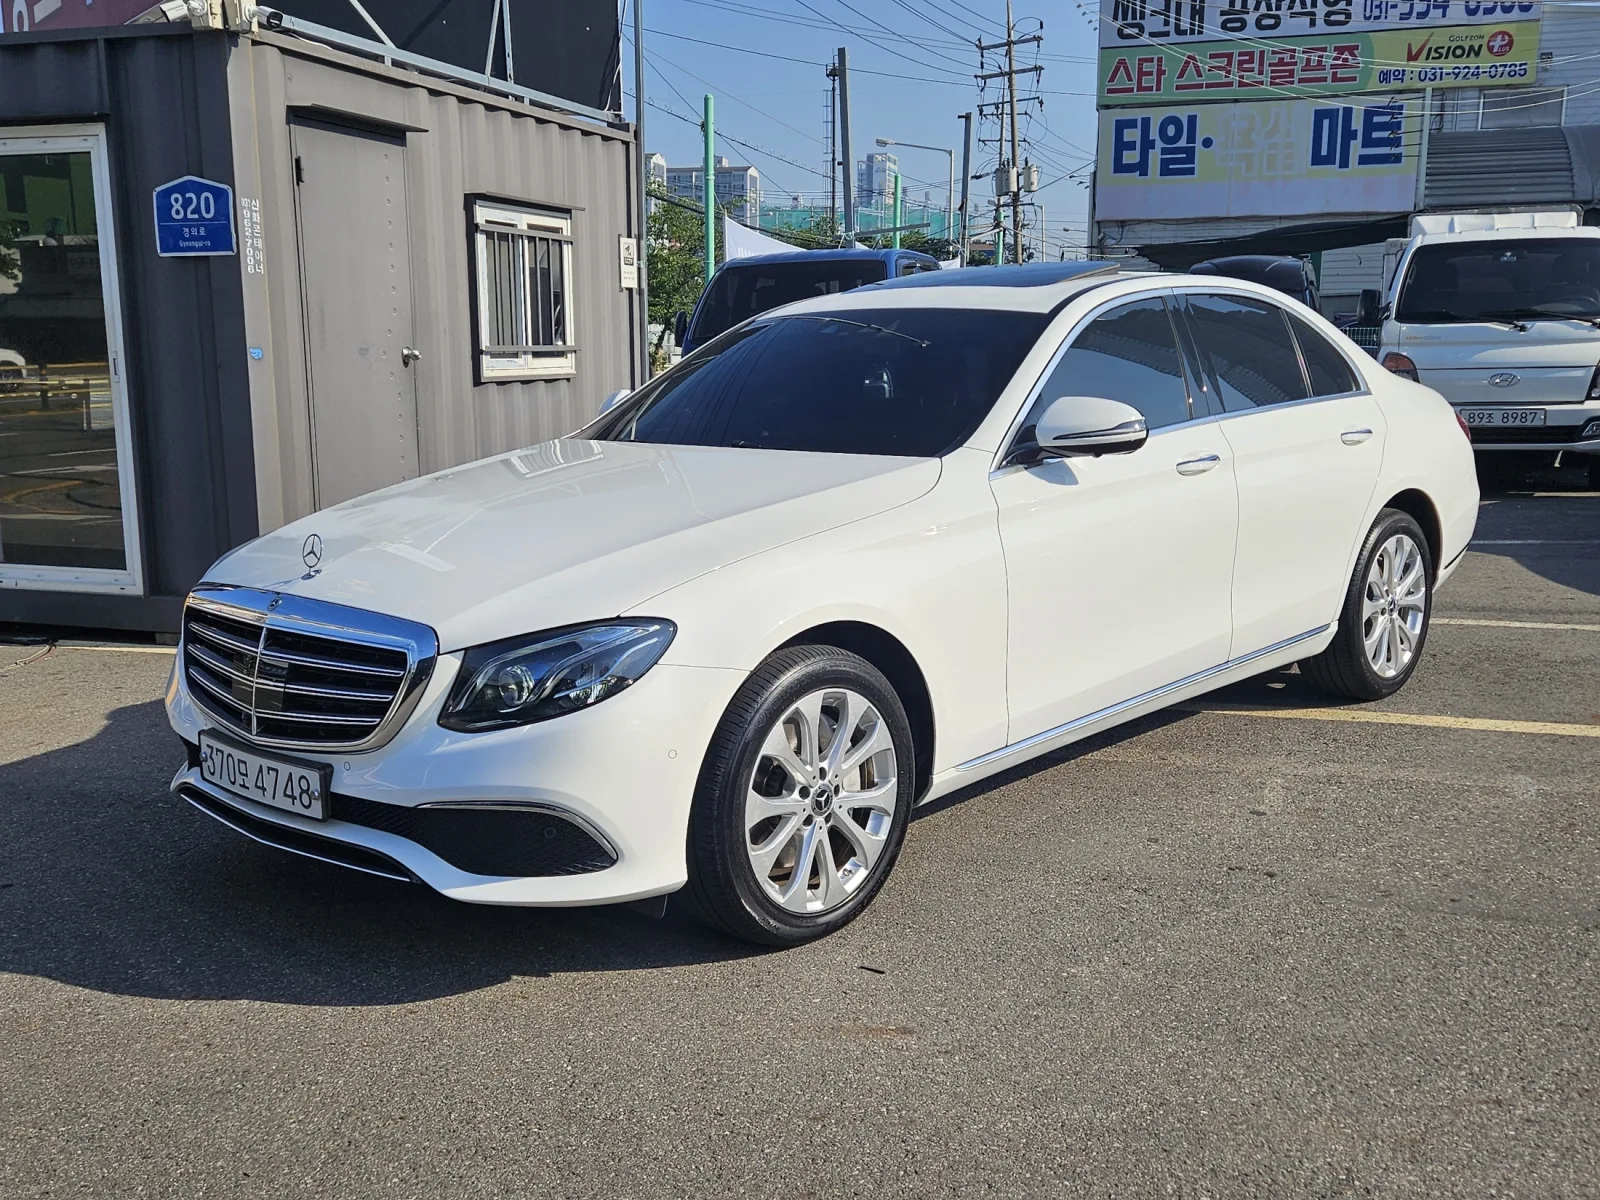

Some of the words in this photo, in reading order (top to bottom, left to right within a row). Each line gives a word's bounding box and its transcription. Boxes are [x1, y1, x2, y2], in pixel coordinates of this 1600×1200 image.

[1406, 31, 1484, 62] VISION
[1105, 55, 1167, 95] 스타
[1174, 44, 1360, 92] 스크린골프존
[1378, 68, 1407, 85] 예약
[1417, 62, 1528, 83] 031-924-0785
[1310, 104, 1404, 169] 마트
[170, 191, 215, 220] 820
[182, 226, 207, 238] 경의로
[1467, 411, 1495, 424] 89조
[1501, 411, 1538, 424] 8987
[254, 763, 313, 810] 4748
